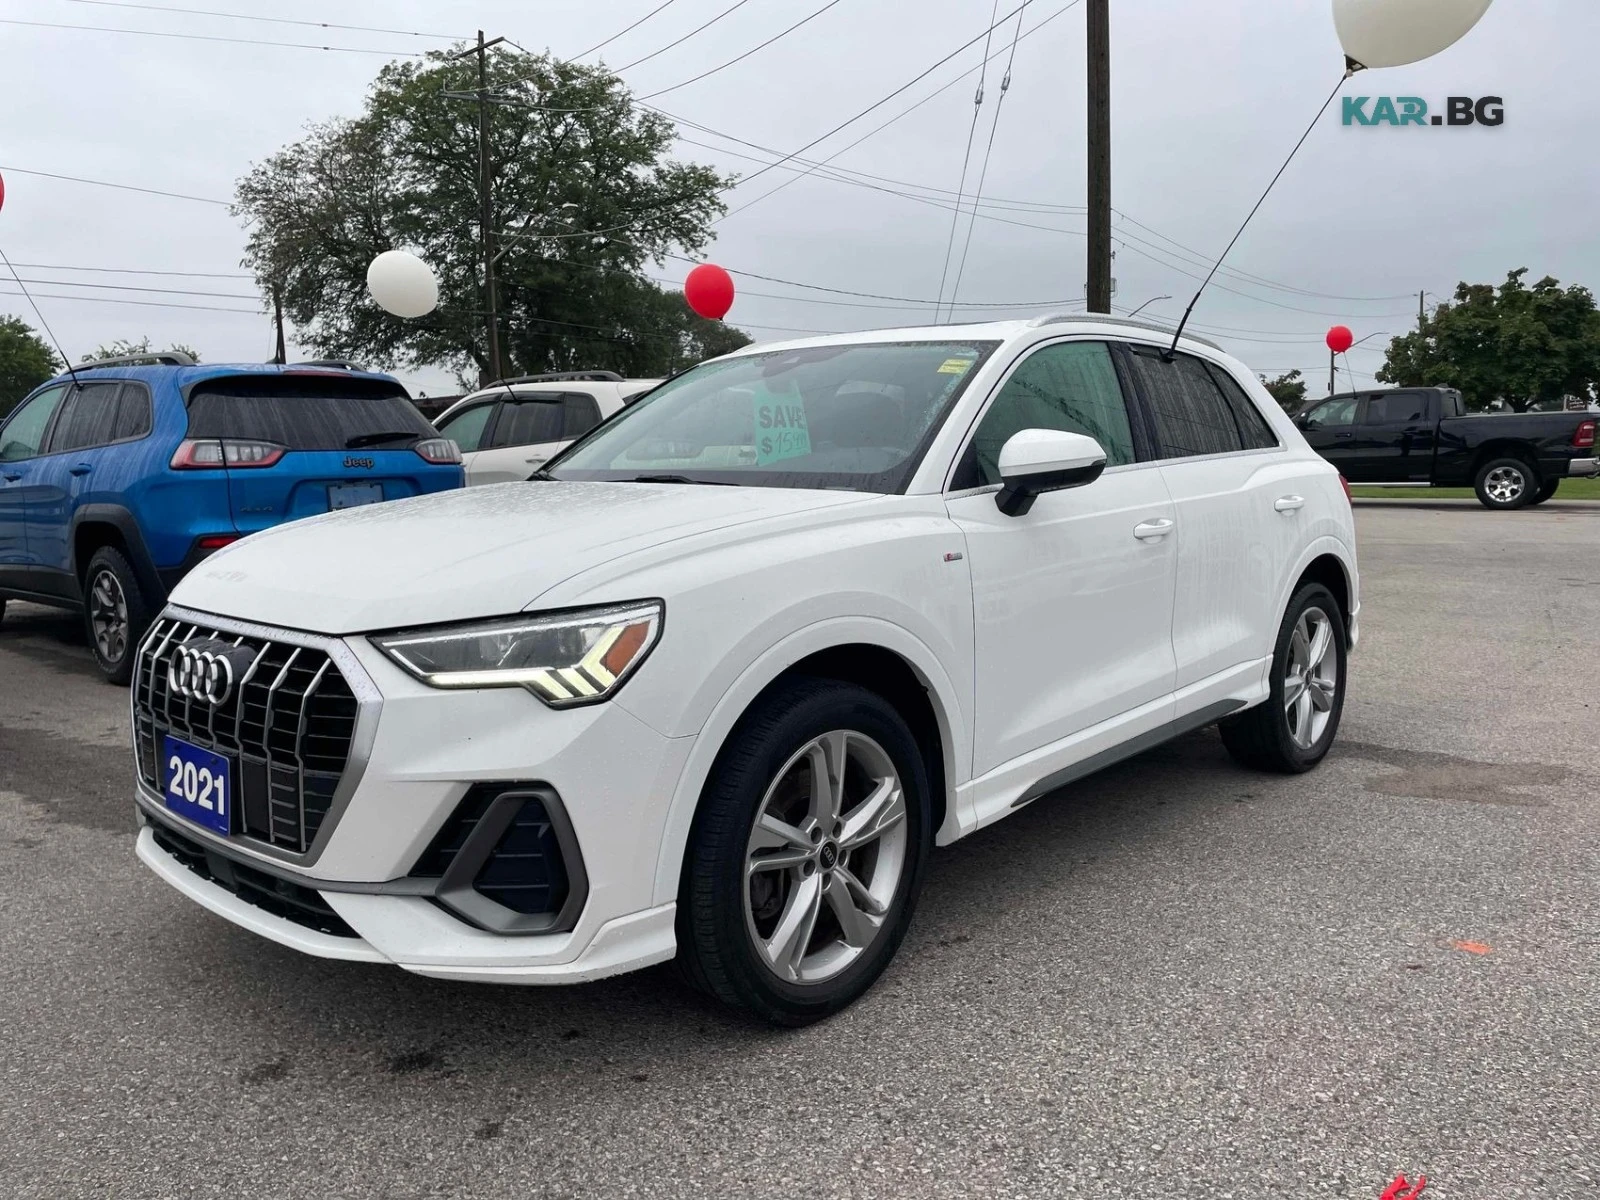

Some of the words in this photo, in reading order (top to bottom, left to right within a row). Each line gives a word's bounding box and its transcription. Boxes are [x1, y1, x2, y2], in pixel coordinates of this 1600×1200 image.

[759, 405, 806, 430] SAVE
[343, 456, 375, 469] Jeep
[169, 755, 225, 816] 2021
